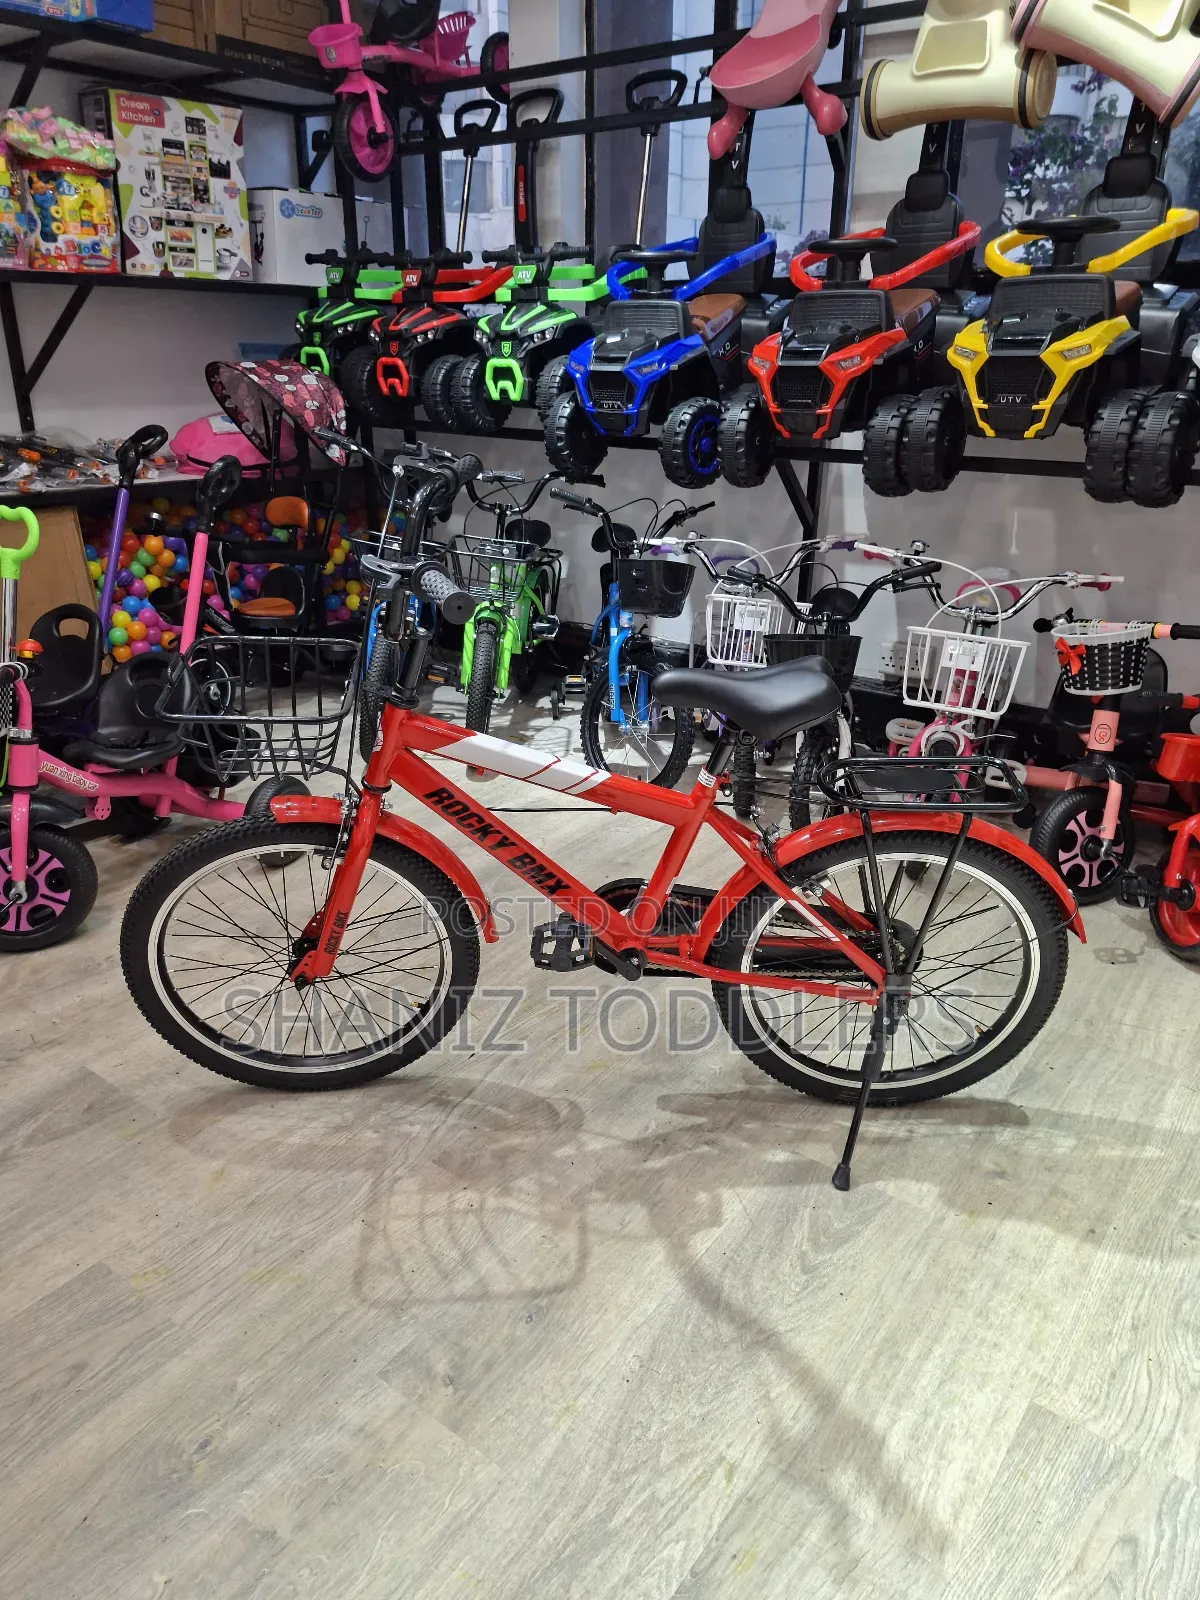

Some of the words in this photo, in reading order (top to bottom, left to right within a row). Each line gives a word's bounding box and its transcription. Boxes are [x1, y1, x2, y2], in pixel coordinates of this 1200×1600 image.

[120, 97, 150, 111] Dream
[121, 111, 156, 124] Kitchen
[329, 272, 340, 280] ATV
[405, 274, 417, 283] ATV
[517, 270, 531, 279] ATV
[39, 761, 59, 775] yuan
[58, 767, 72, 783] xing
[72, 771, 88, 790] baby
[87, 781, 99, 791] car
[423, 787, 518, 851] ROCKY
[507, 852, 571, 896] BMX
[325, 928, 341, 955] ROCKY
[333, 909, 349, 929] BMX
